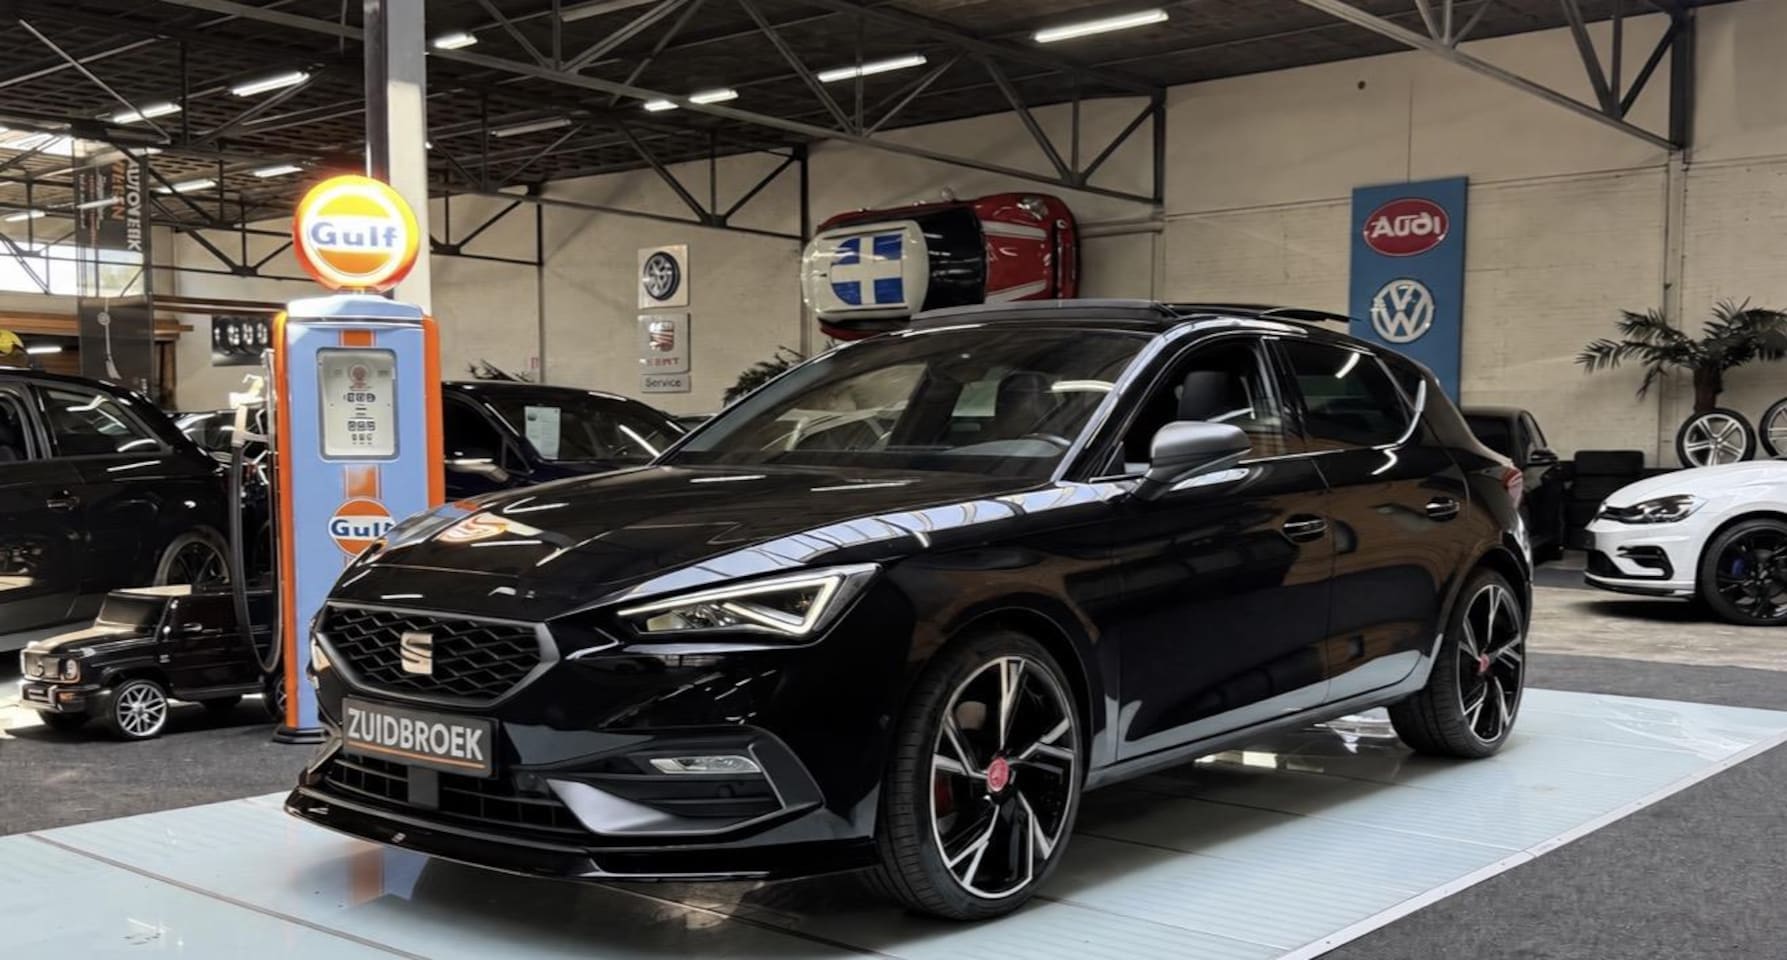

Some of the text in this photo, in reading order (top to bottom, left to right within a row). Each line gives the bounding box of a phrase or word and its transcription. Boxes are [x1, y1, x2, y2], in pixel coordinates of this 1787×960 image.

[311, 222, 398, 247] Gulf
[645, 377, 681, 388] Service
[348, 707, 484, 761] ZUIDBROEK
